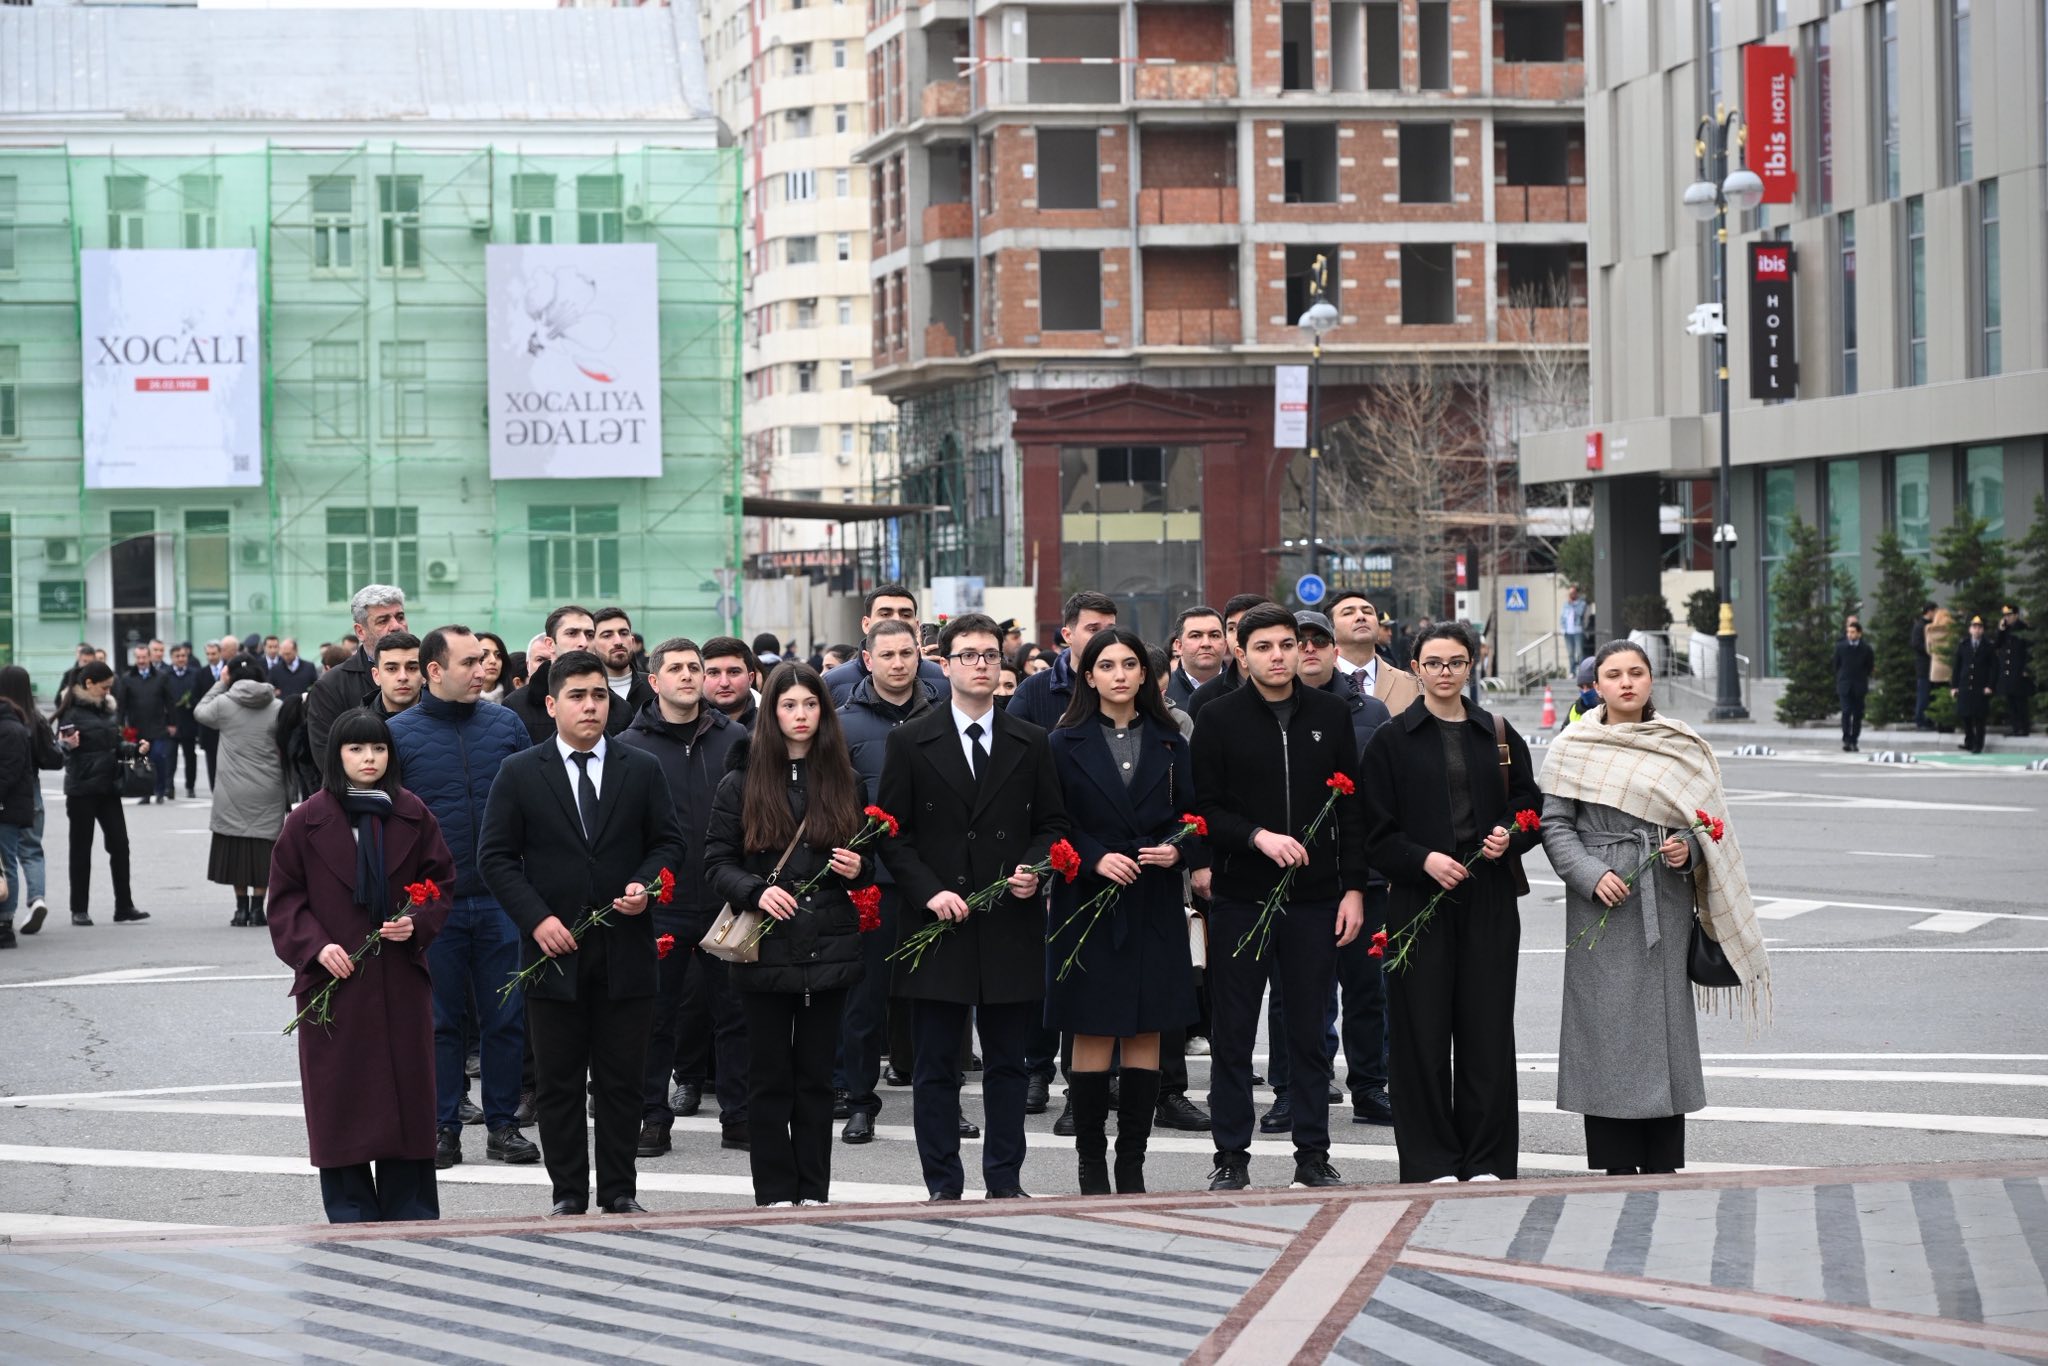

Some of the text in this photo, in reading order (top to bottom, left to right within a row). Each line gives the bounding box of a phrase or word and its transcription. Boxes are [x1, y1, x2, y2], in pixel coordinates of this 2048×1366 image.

[1764, 74, 1786, 176] ibis HOTEL
[1758, 255, 1786, 272] ibis
[1767, 294, 1780, 388] HOTEL
[504, 390, 646, 414] XOCALIYA
[505, 418, 647, 447] ƏDALƏT
